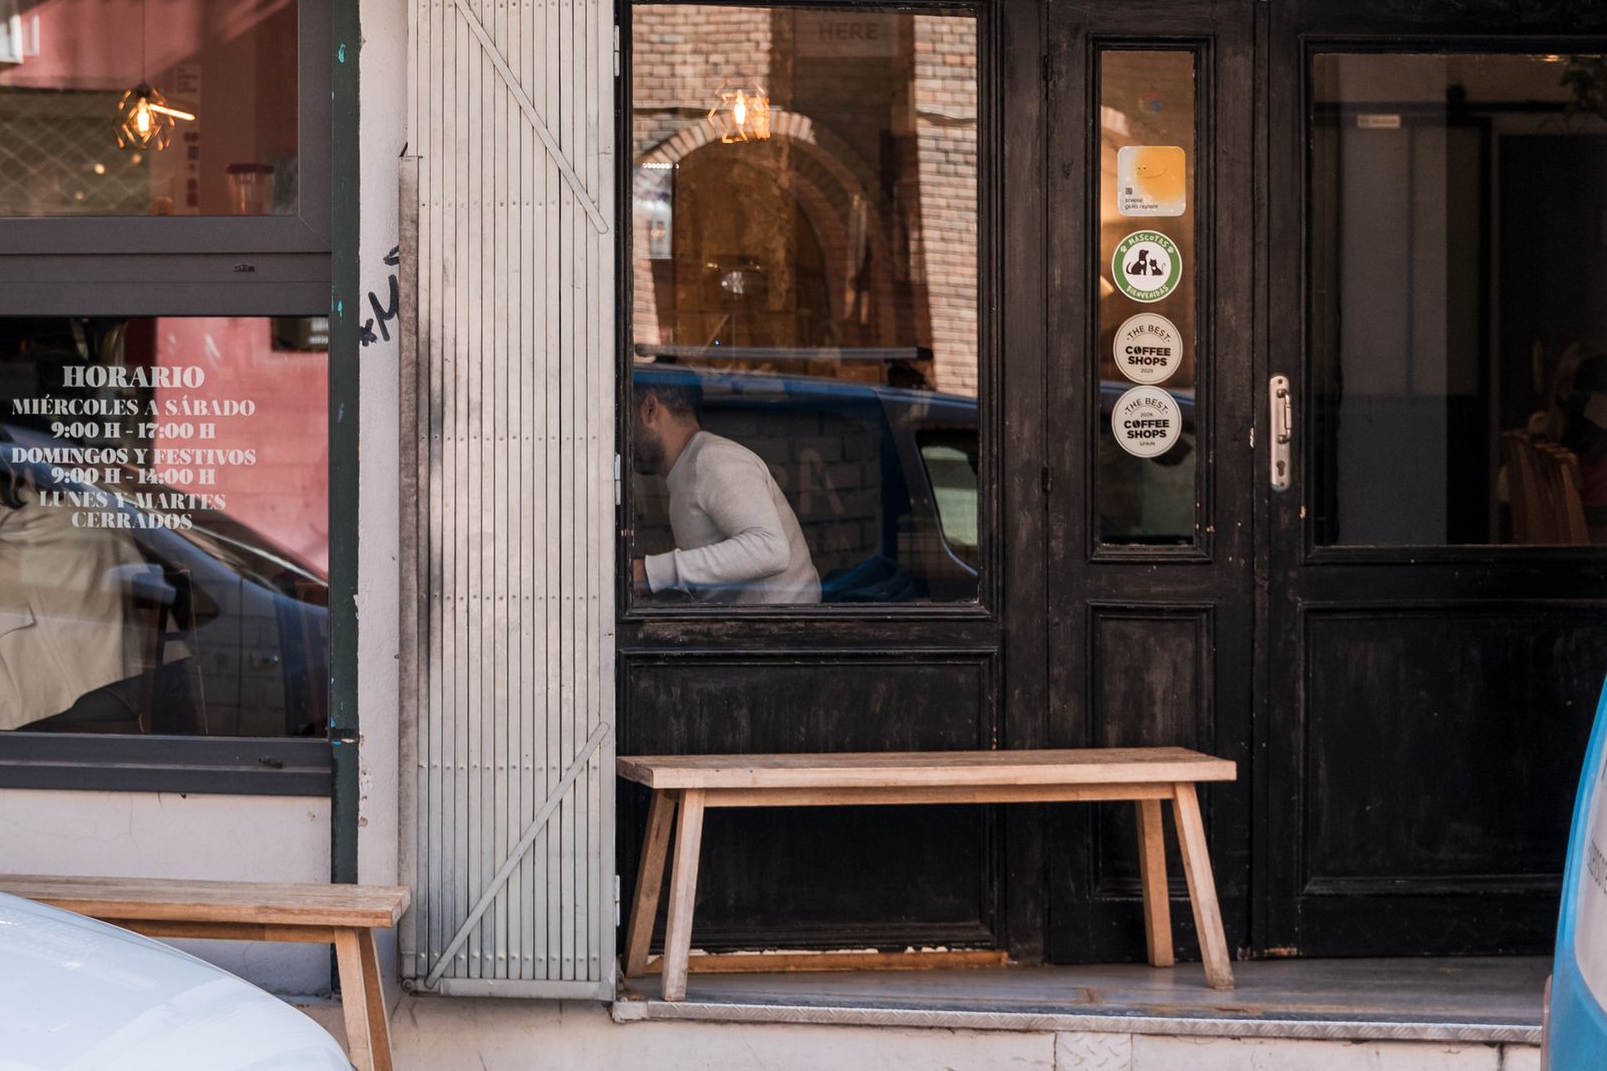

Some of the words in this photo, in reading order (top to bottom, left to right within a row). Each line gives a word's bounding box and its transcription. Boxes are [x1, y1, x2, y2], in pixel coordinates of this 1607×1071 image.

[819, 21, 879, 40] HERE
[1127, 325, 1145, 339] THE
[1148, 324, 1171, 340] BEST
[1125, 346, 1171, 356] COFFEE
[1128, 356, 1167, 366] SHOPS
[62, 365, 205, 388] HORARIO
[12, 394, 138, 416] MIÉRCOLES
[144, 399, 159, 416] A
[165, 395, 256, 416] SÁBADO
[1125, 398, 1142, 412] THE
[1145, 397, 1168, 412] BEST
[51, 422, 99, 439] 9:00
[104, 423, 121, 439] H
[137, 422, 193, 439] 17:00
[199, 423, 216, 439] H
[1124, 419, 1170, 429] COFFEE
[1127, 429, 1167, 439] SHOPS
[11, 447, 128, 465] DOMINGOS
[133, 448, 148, 464] Y
[153, 448, 256, 465] FESTIVOS
[51, 467, 99, 484] 9:00
[104, 468, 121, 484] H
[137, 468, 193, 484] 14:00
[199, 468, 216, 484] H
[39, 491, 107, 508] LUNES
[114, 492, 130, 509] Y
[135, 492, 226, 510] MARTES
[71, 512, 193, 530] CERRADOS
